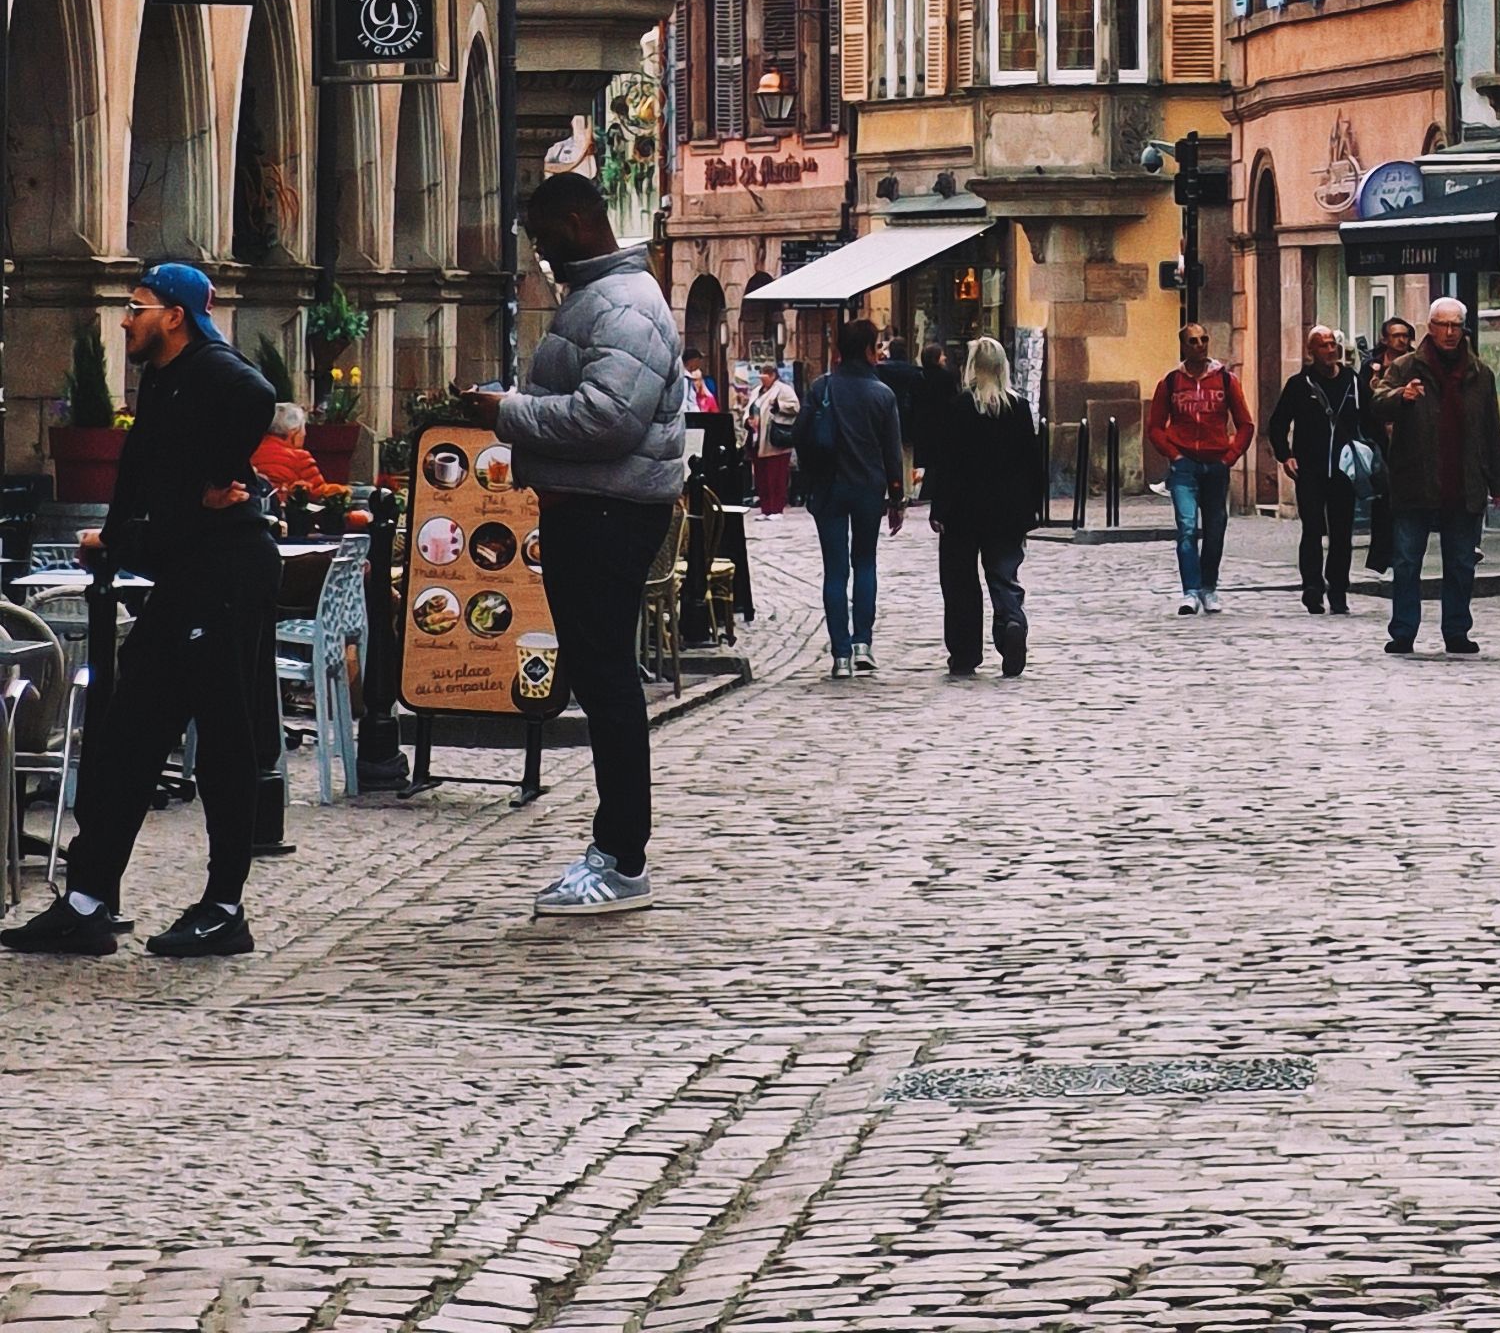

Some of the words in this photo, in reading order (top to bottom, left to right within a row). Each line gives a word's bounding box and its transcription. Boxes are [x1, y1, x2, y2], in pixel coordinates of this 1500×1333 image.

[357, 33, 371, 47] LA
[374, 30, 423, 55] GALERIA
[432, 667, 454, 680] sur
[455, 663, 492, 681] place
[415, 683, 432, 696] ou
[446, 679, 504, 695] emporter
